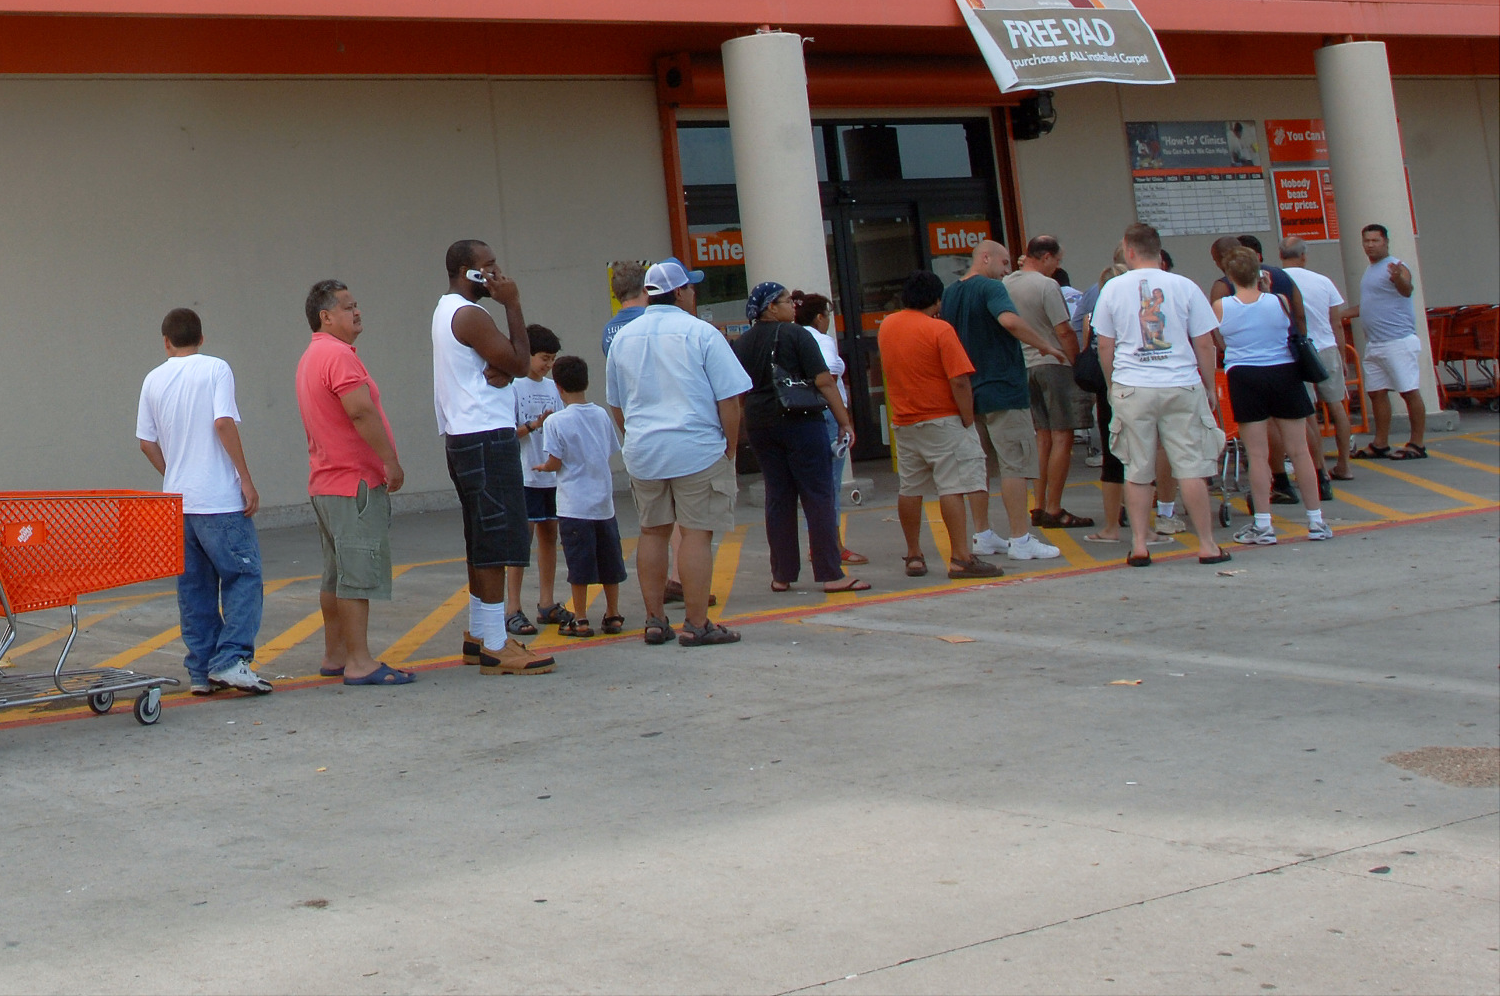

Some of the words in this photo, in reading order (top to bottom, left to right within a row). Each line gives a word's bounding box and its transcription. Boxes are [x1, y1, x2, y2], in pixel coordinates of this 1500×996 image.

[1002, 18, 1069, 49] FREE
[1061, 17, 1115, 47] PAD
[1012, 54, 1057, 70] purchase
[1058, 52, 1069, 63] of
[1070, 51, 1088, 62] ALL
[1119, 53, 1149, 65] Carpet
[1286, 131, 1304, 142] You
[1305, 130, 1321, 141] Can
[1280, 178, 1310, 190] Nobody
[1287, 190, 1308, 199] beats
[1280, 202, 1293, 210] our
[1294, 200, 1319, 212] prices.
[936, 227, 987, 249] Enter
[696, 237, 743, 261] Ente
